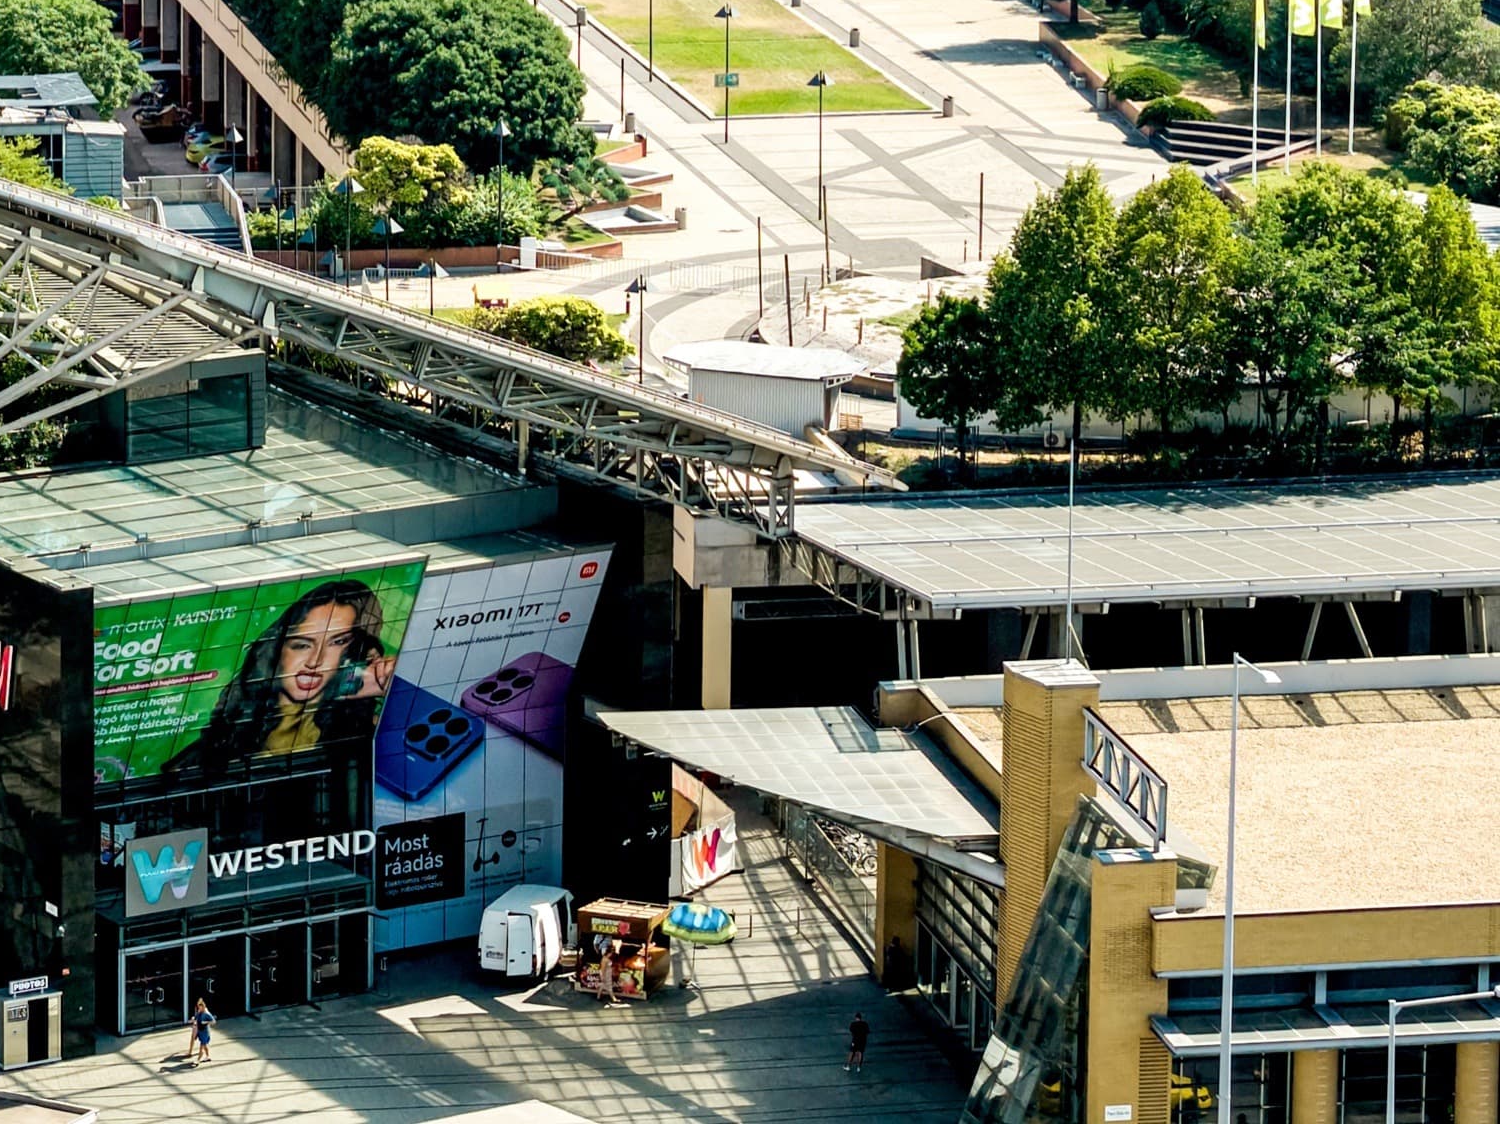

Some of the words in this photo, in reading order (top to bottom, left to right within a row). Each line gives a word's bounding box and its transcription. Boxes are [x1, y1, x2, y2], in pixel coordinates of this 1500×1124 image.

[109, 616, 166, 636] matrix
[173, 606, 238, 627] KATSEYE
[518, 602, 544, 619] 17T
[94, 632, 163, 661] Food
[132, 650, 197, 678] Soft
[209, 829, 377, 879] WESTEND
[384, 832, 430, 856] Most
[384, 851, 444, 877] ráadás
[12, 978, 46, 992] PHOTOS
